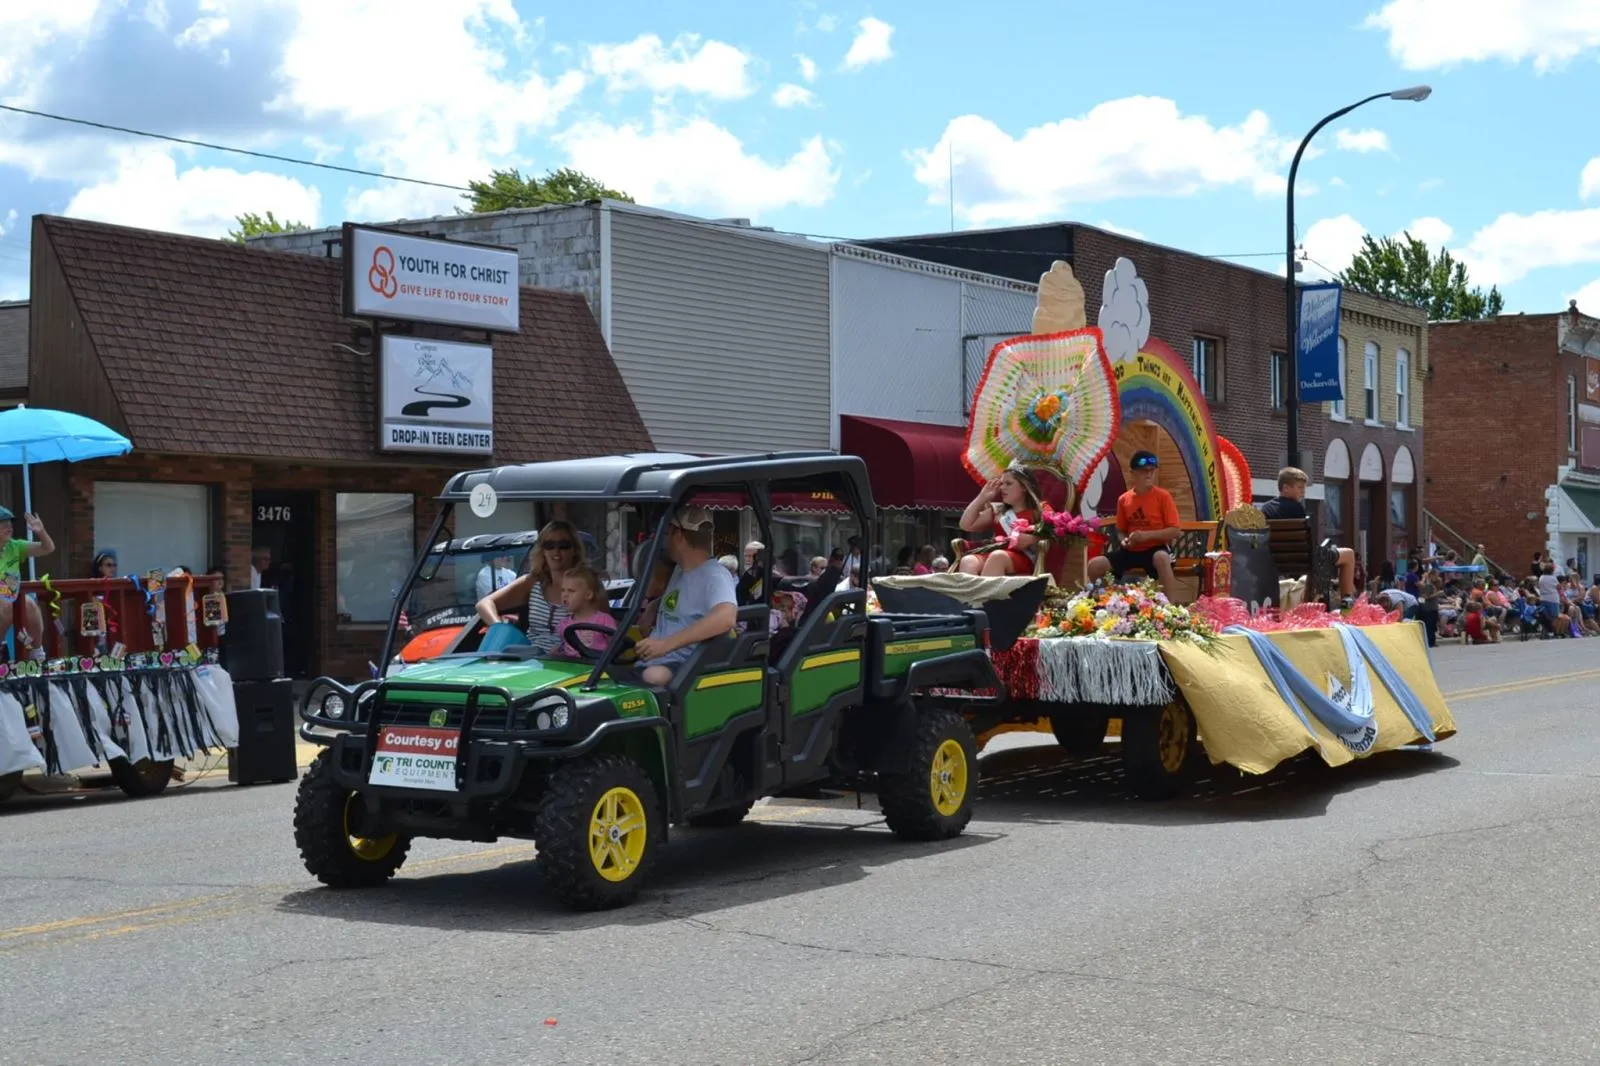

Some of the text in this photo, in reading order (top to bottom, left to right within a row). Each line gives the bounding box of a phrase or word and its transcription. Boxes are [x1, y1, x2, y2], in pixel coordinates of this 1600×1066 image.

[399, 256, 508, 284] YOUTH FOR CHRIST
[400, 284, 510, 307] GIVE LIFE TO YOUR STORY
[392, 428, 491, 448] DROP-IN TEEN CENTER
[257, 505, 291, 521] 3476
[385, 732, 459, 751] Courtesy of
[395, 767, 456, 779] EQUIPMENT
[396, 757, 457, 771] TRI COUNTY
